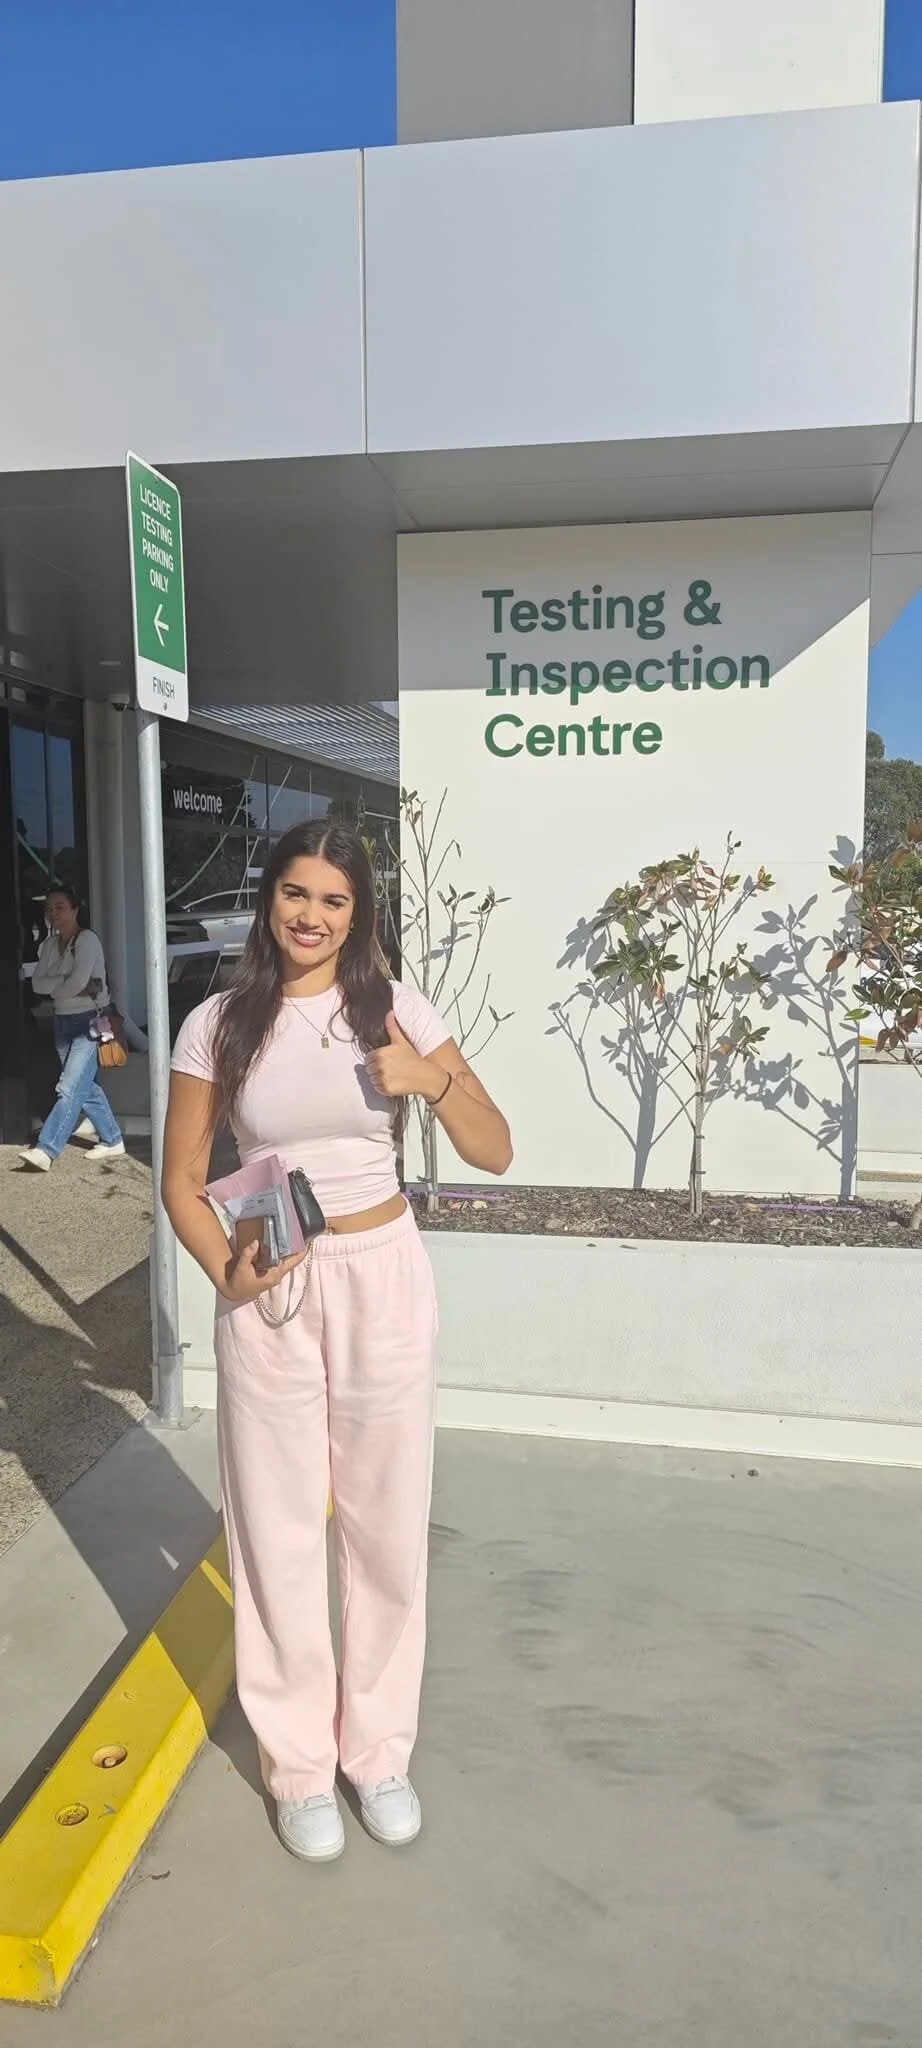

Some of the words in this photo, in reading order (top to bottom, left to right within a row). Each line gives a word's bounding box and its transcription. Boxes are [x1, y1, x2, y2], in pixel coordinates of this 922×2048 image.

[140, 483, 171, 520] LICENCE
[141, 511, 172, 546] TESTING
[142, 537, 174, 572] PARKING
[150, 568, 168, 593] ONLY
[482, 585, 666, 640] Testing
[684, 580, 722, 626] &
[153, 677, 175, 699] FINISH
[486, 644, 769, 705] Inspection
[485, 714, 663, 757] Centre
[173, 785, 222, 814] welcome
